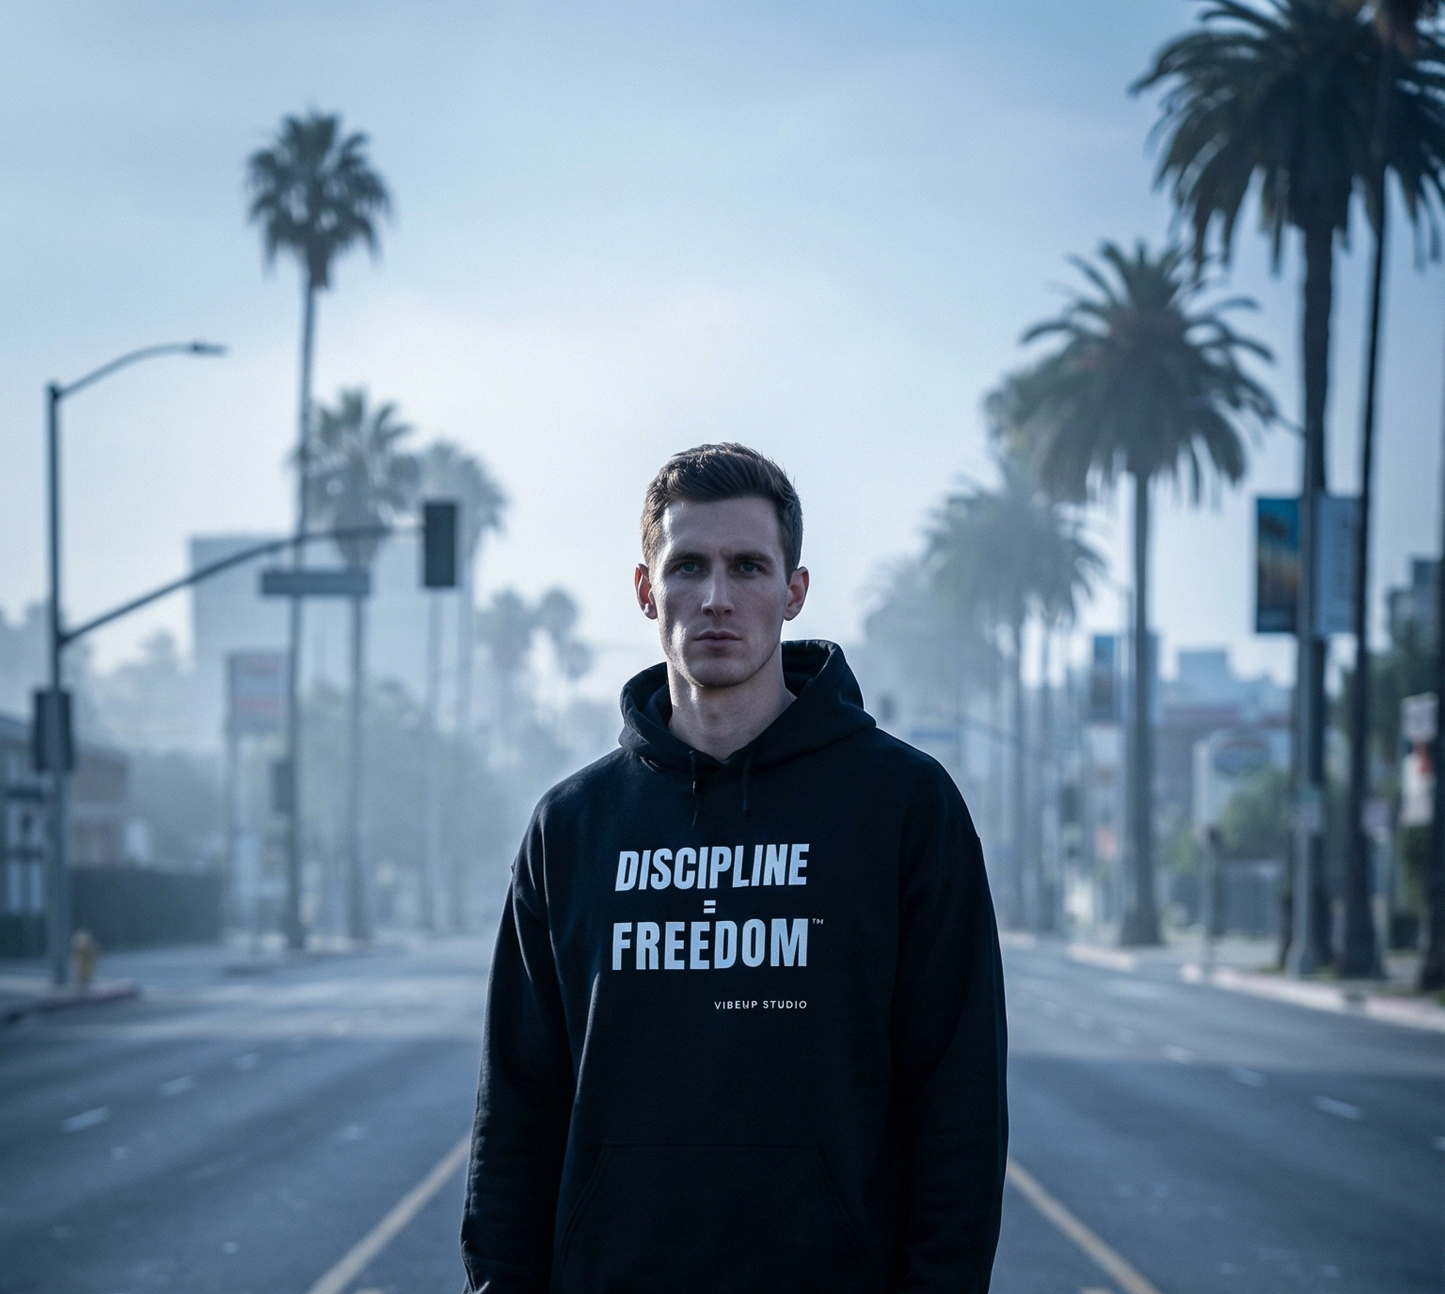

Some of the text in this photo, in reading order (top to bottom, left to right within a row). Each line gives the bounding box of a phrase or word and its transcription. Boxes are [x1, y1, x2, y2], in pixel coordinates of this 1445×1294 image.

[614, 843, 810, 892] DISCIPLINE
[703, 900, 717, 914] =
[762, 1000, 808, 1010] STUDIO
